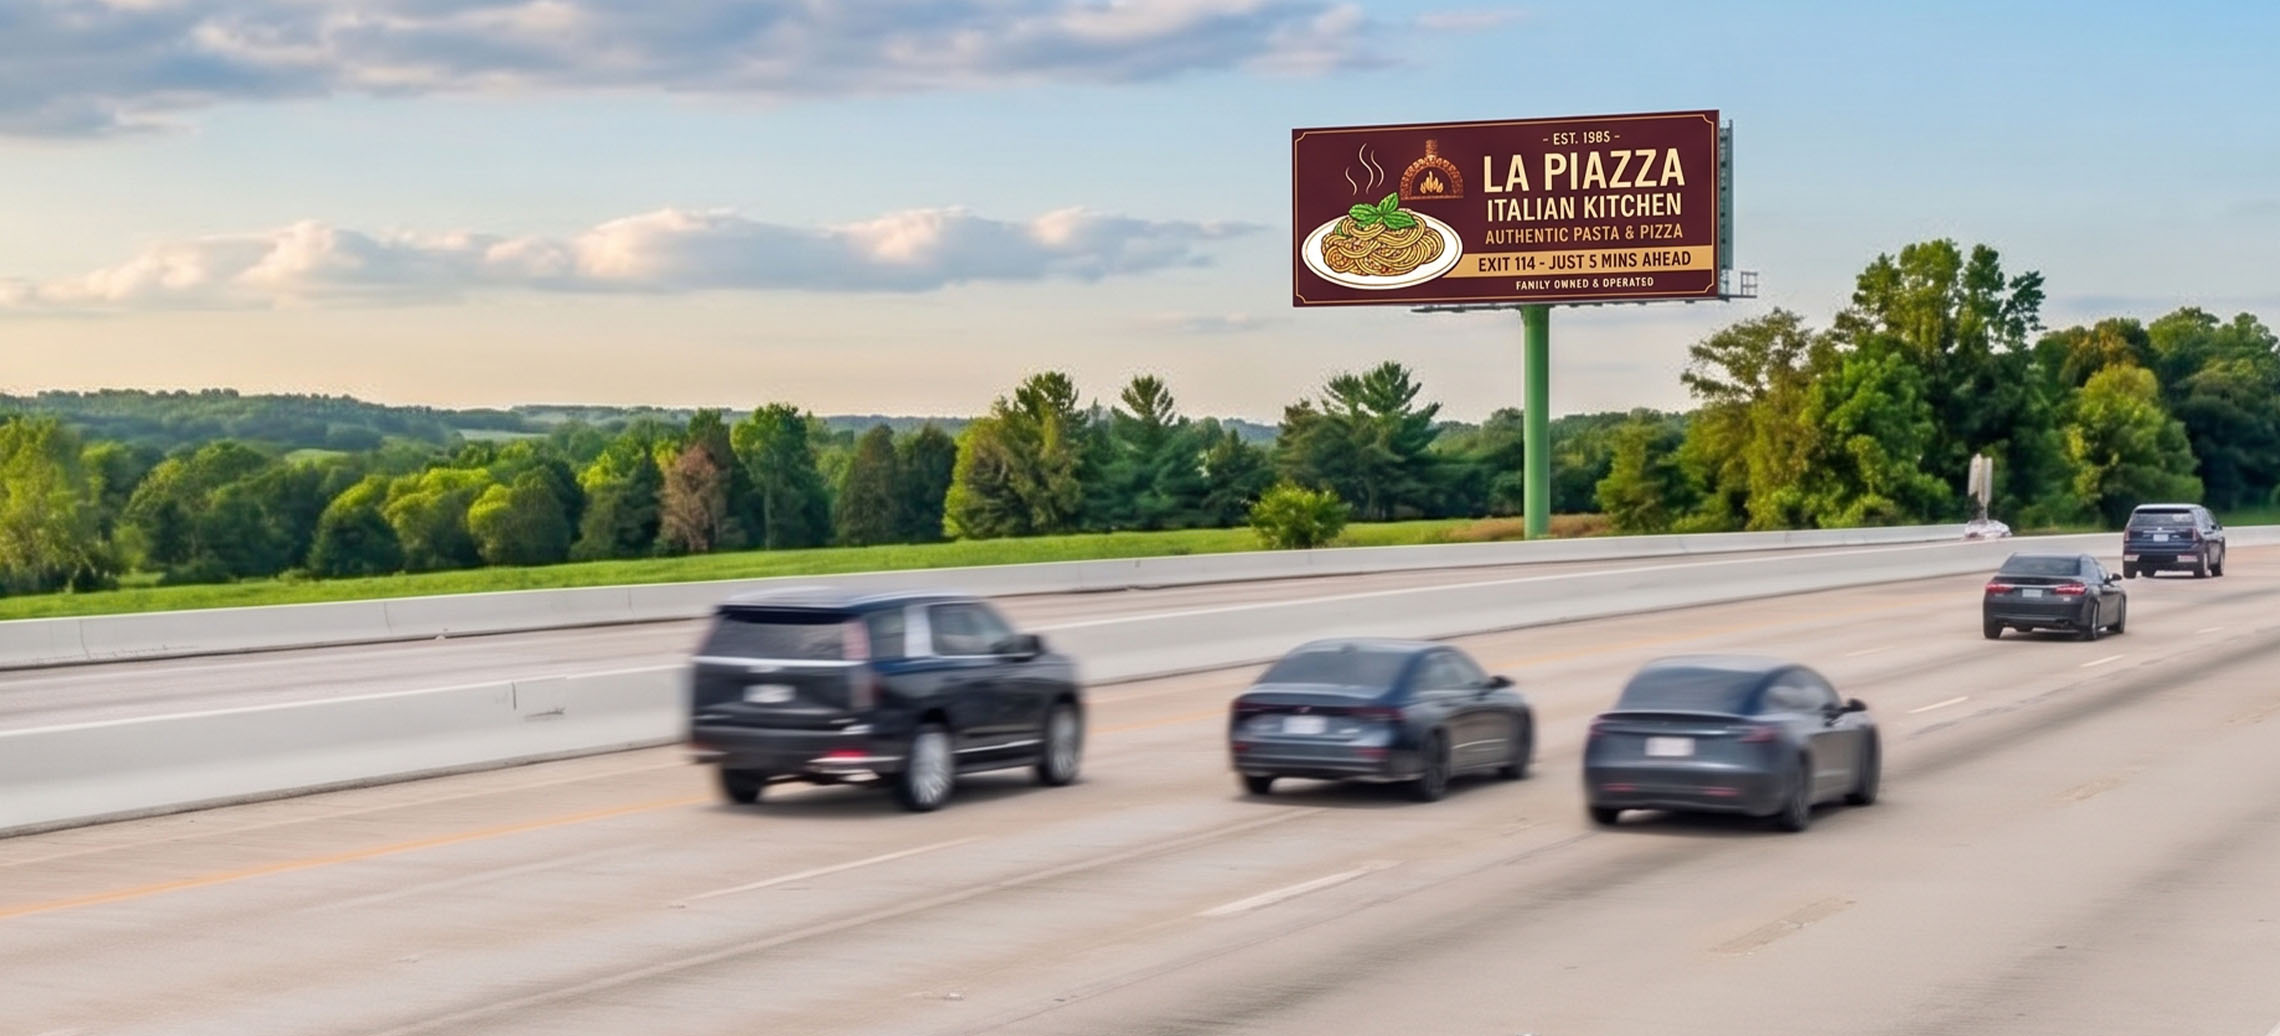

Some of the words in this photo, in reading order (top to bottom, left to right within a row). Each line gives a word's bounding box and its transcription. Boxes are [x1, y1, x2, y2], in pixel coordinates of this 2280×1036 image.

[1553, 132, 1578, 145] EST.
[1583, 130, 1610, 144] 1985
[1484, 154, 1530, 193] LA
[1544, 148, 1685, 191] PIAZZA
[1487, 197, 1575, 222] ITALIAN
[1584, 192, 1682, 219] KITCHEN
[1485, 228, 1569, 245] AUTHENTIC
[1573, 226, 1620, 241] PASTA
[1624, 225, 1635, 240] &
[1640, 224, 1684, 239] PIZZA
[1478, 257, 1510, 272] EXIT
[1515, 256, 1536, 271] 114
[1549, 254, 1585, 270] JUST
[1589, 254, 1598, 269] 5
[1601, 252, 1638, 268] MINS
[1642, 251, 1692, 267] AHEAD
[1554, 279, 1589, 289] OWNED
[1592, 279, 1600, 289] &
